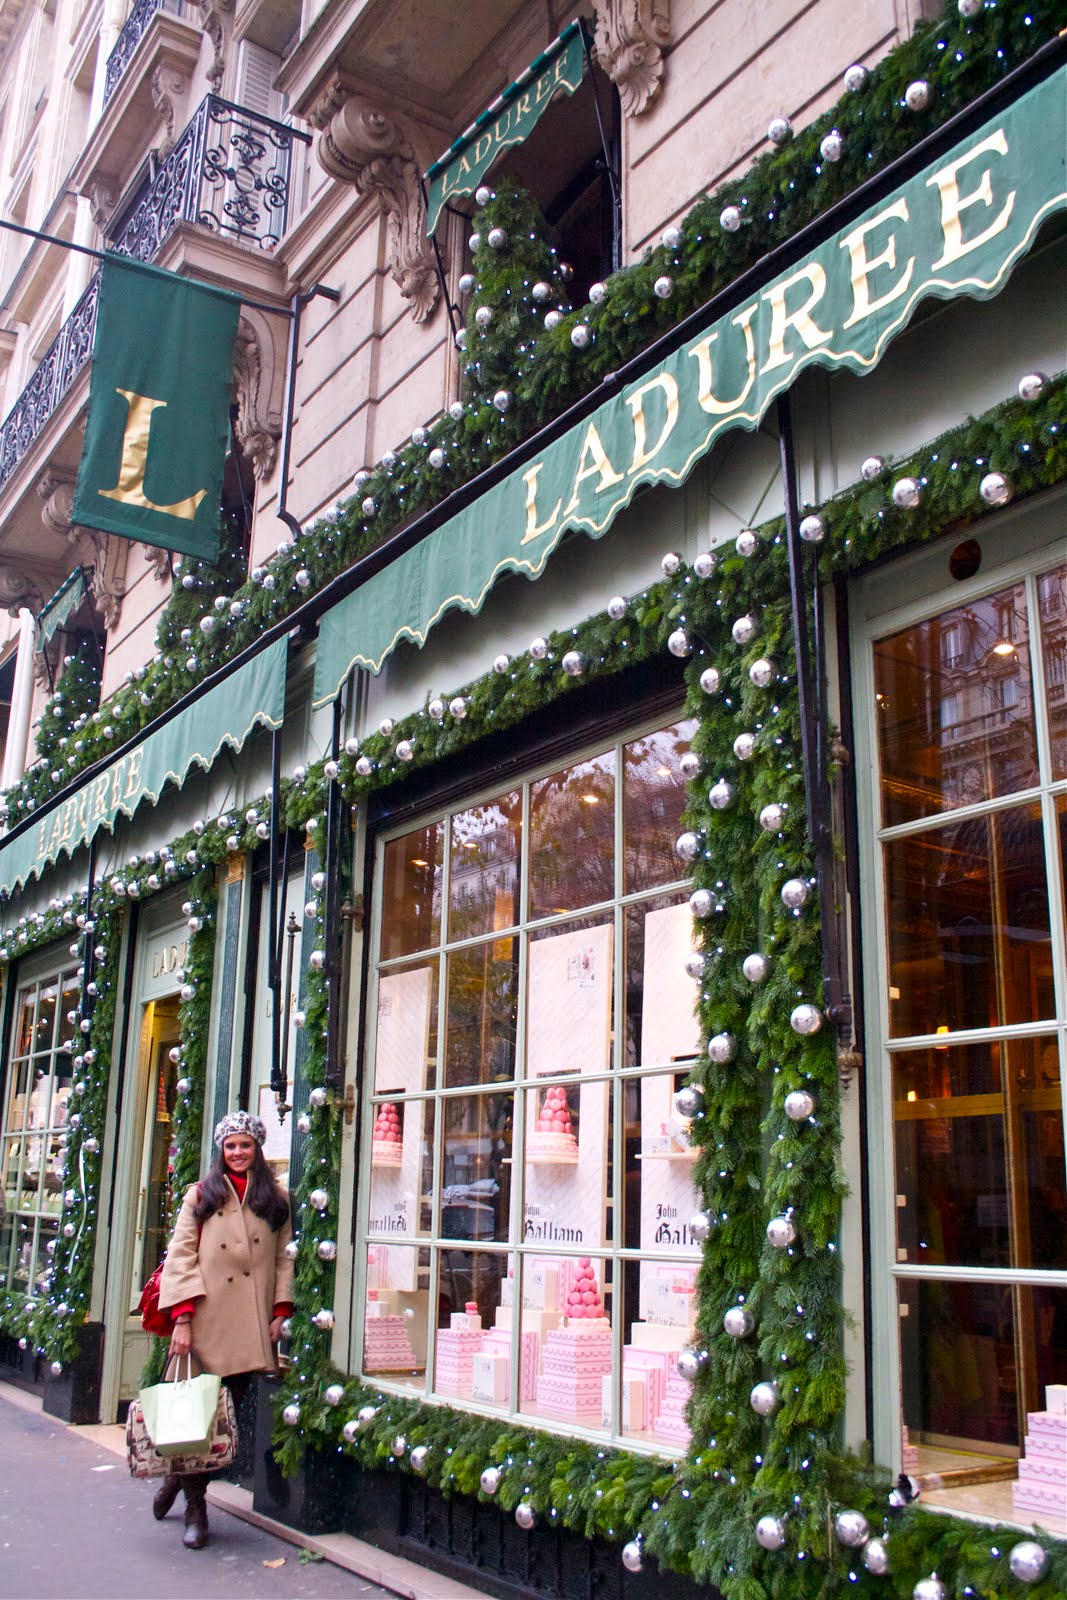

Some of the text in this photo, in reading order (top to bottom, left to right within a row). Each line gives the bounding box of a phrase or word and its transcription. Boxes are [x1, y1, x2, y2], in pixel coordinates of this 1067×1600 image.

[441, 48, 568, 197] LADUREE
[520, 128, 1017, 546] LADUREE
[98, 387, 208, 520] L
[37, 746, 144, 860] LADUREE
[525, 1219, 583, 1242] Galliano
[655, 1203, 677, 1219] John
